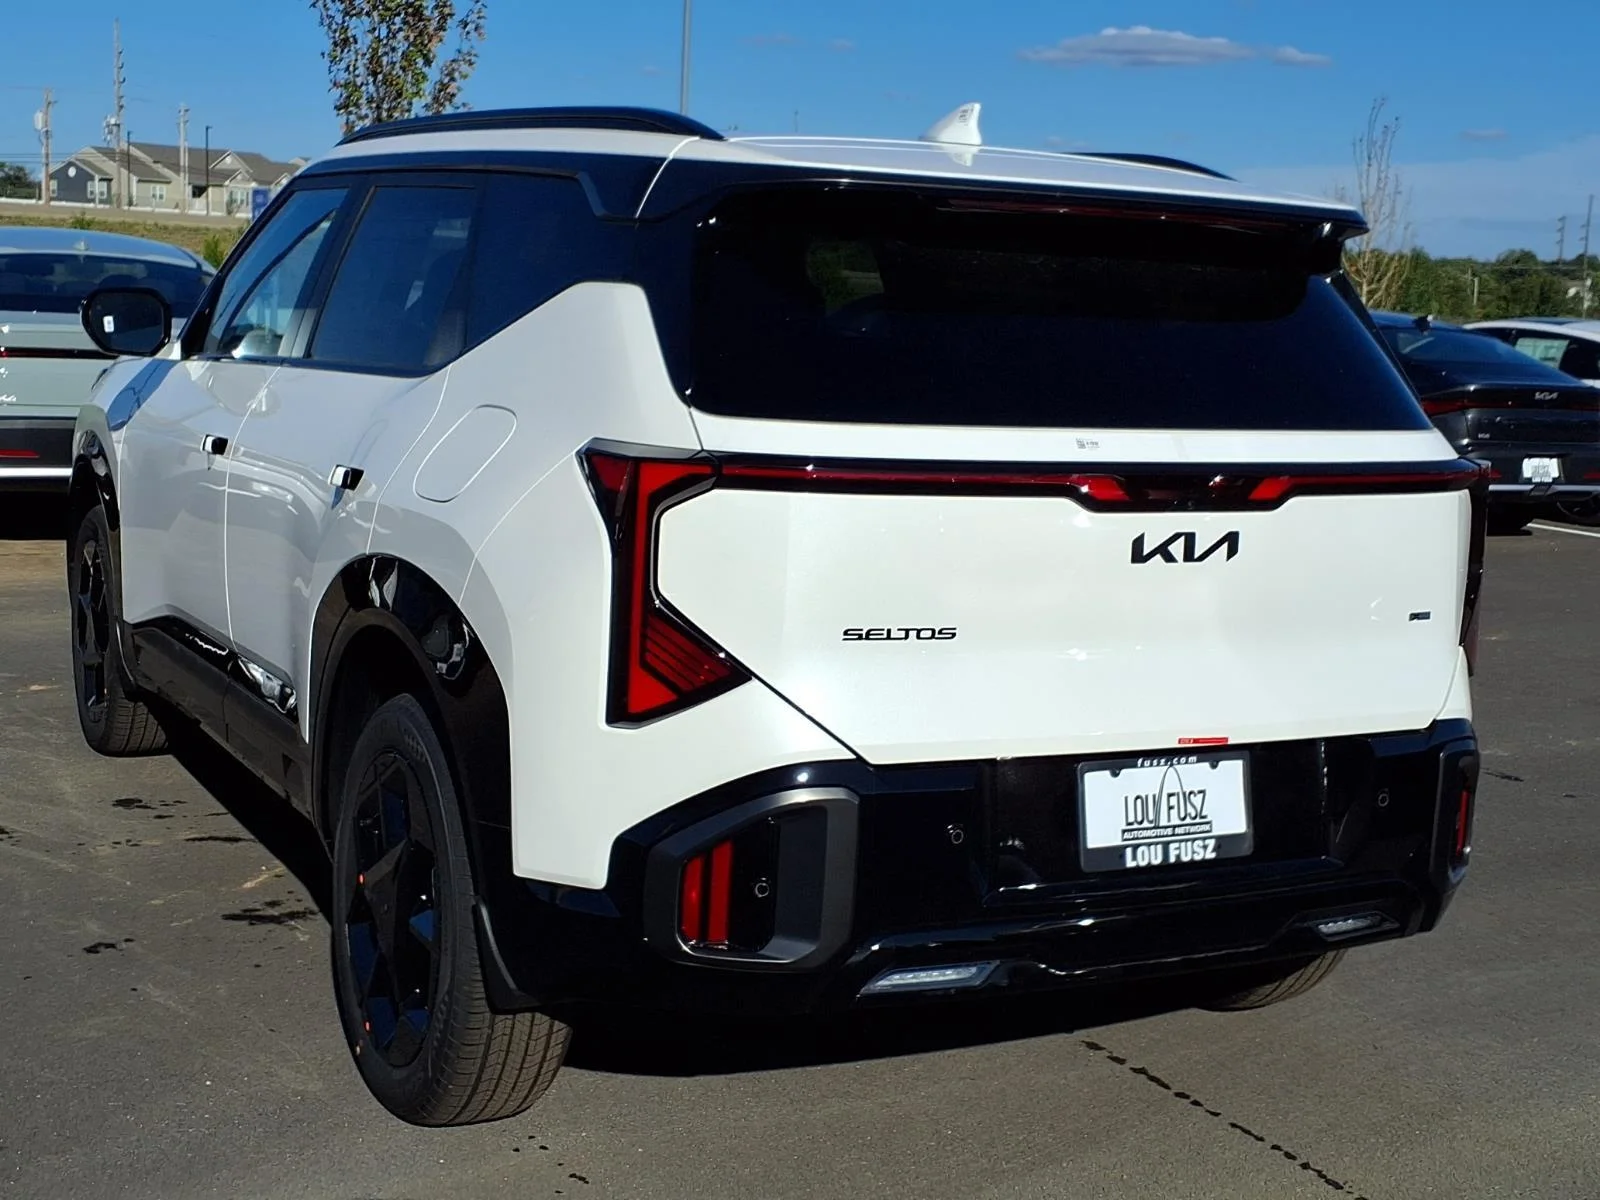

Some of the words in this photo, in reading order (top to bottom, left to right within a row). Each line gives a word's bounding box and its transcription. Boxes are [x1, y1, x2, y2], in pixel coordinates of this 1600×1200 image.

[1130, 530, 1240, 564] KIA
[842, 627, 957, 641] SELTOS
[1137, 756, 1198, 768] fusz.com
[1124, 794, 1158, 827] LOU
[1166, 789, 1208, 823] FUSZ
[1122, 829, 1173, 840] AUTOMOTIVE
[1174, 824, 1212, 836] NETWORK
[1125, 845, 1163, 868] LOU
[1168, 839, 1217, 863] FUSZ
